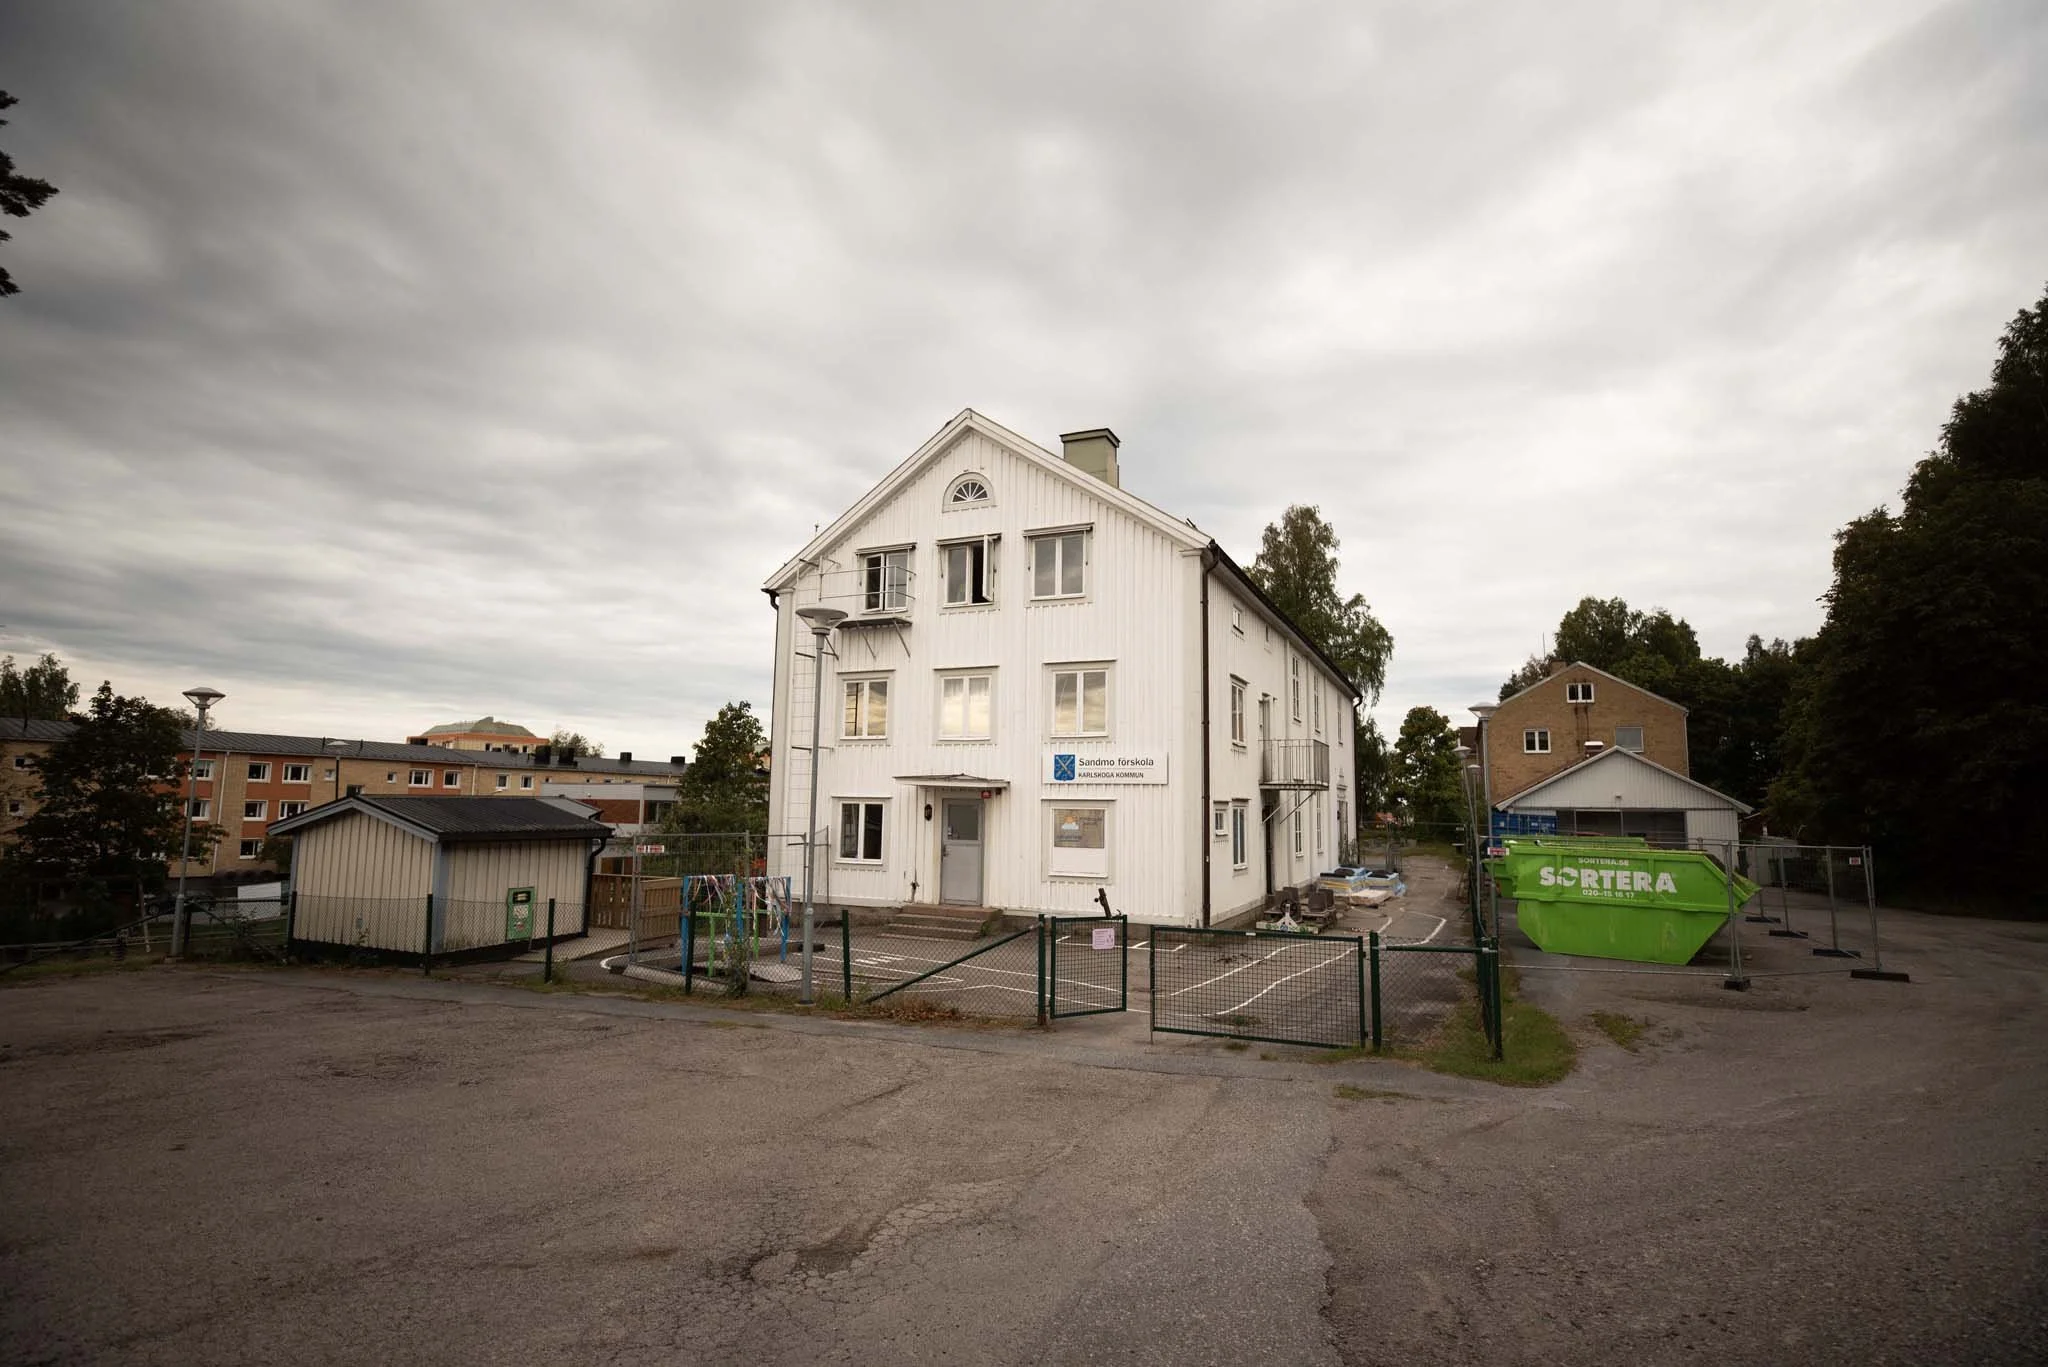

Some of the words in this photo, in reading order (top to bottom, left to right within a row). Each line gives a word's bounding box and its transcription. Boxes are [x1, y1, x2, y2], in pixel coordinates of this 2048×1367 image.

[1078, 758, 1115, 766] Sandmo
[1118, 757, 1154, 766] förskola
[1540, 866, 1677, 893] SORTERA
